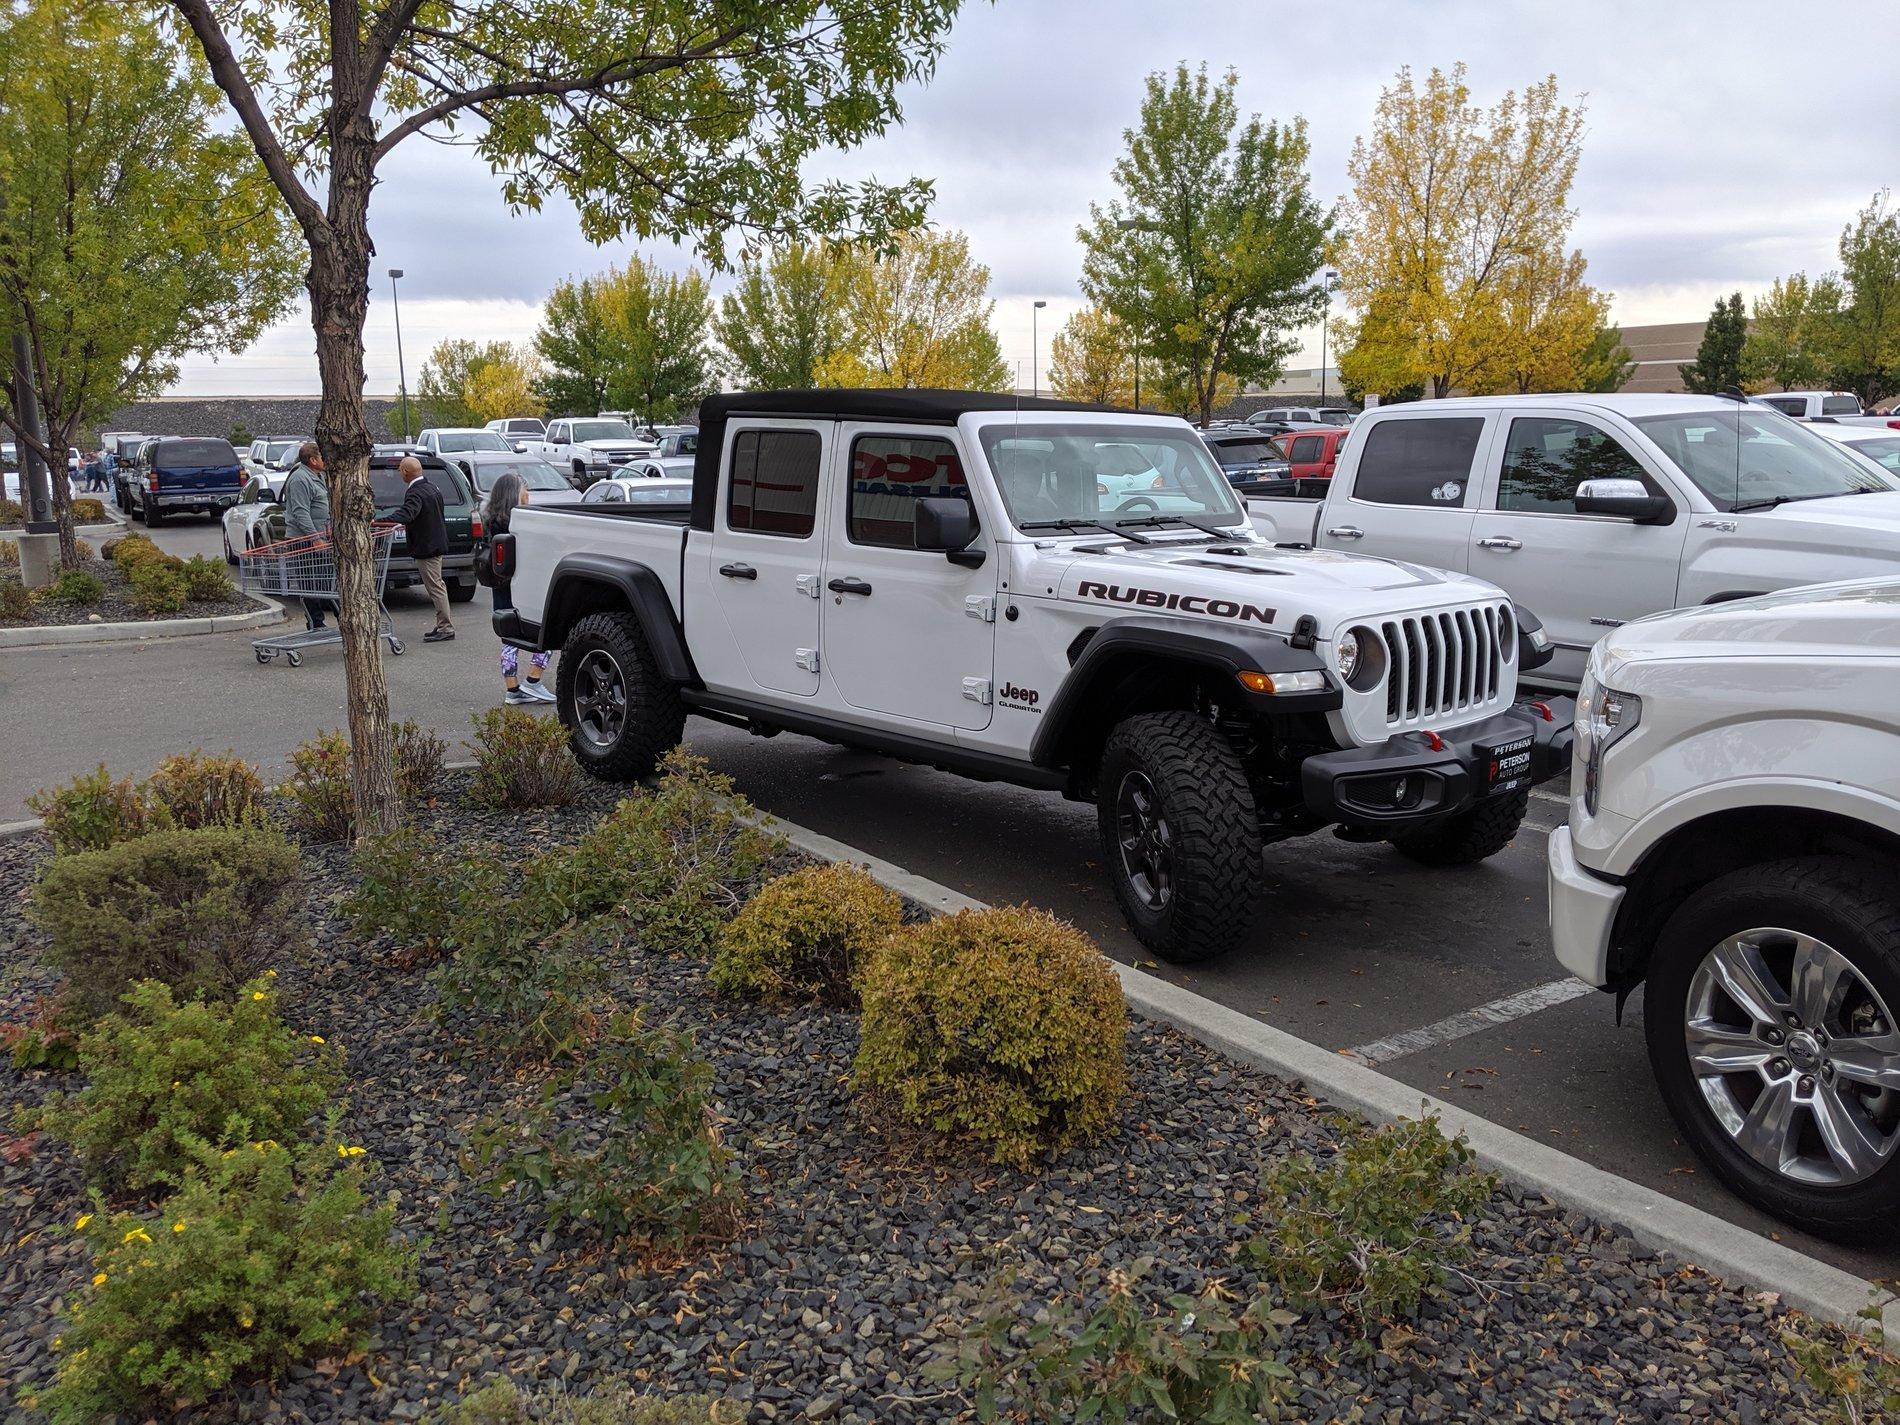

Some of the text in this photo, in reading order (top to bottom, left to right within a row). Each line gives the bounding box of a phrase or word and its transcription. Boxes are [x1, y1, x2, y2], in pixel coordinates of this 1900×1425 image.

[1077, 580, 1277, 624] RUBICON
[999, 681, 1039, 706] Jeep
[998, 700, 1042, 714] GLADIATOR
[1494, 738, 1531, 755] PETERSON
[1499, 751, 1530, 769] PETERSON
[1499, 762, 1530, 779] AUTO GROUP
